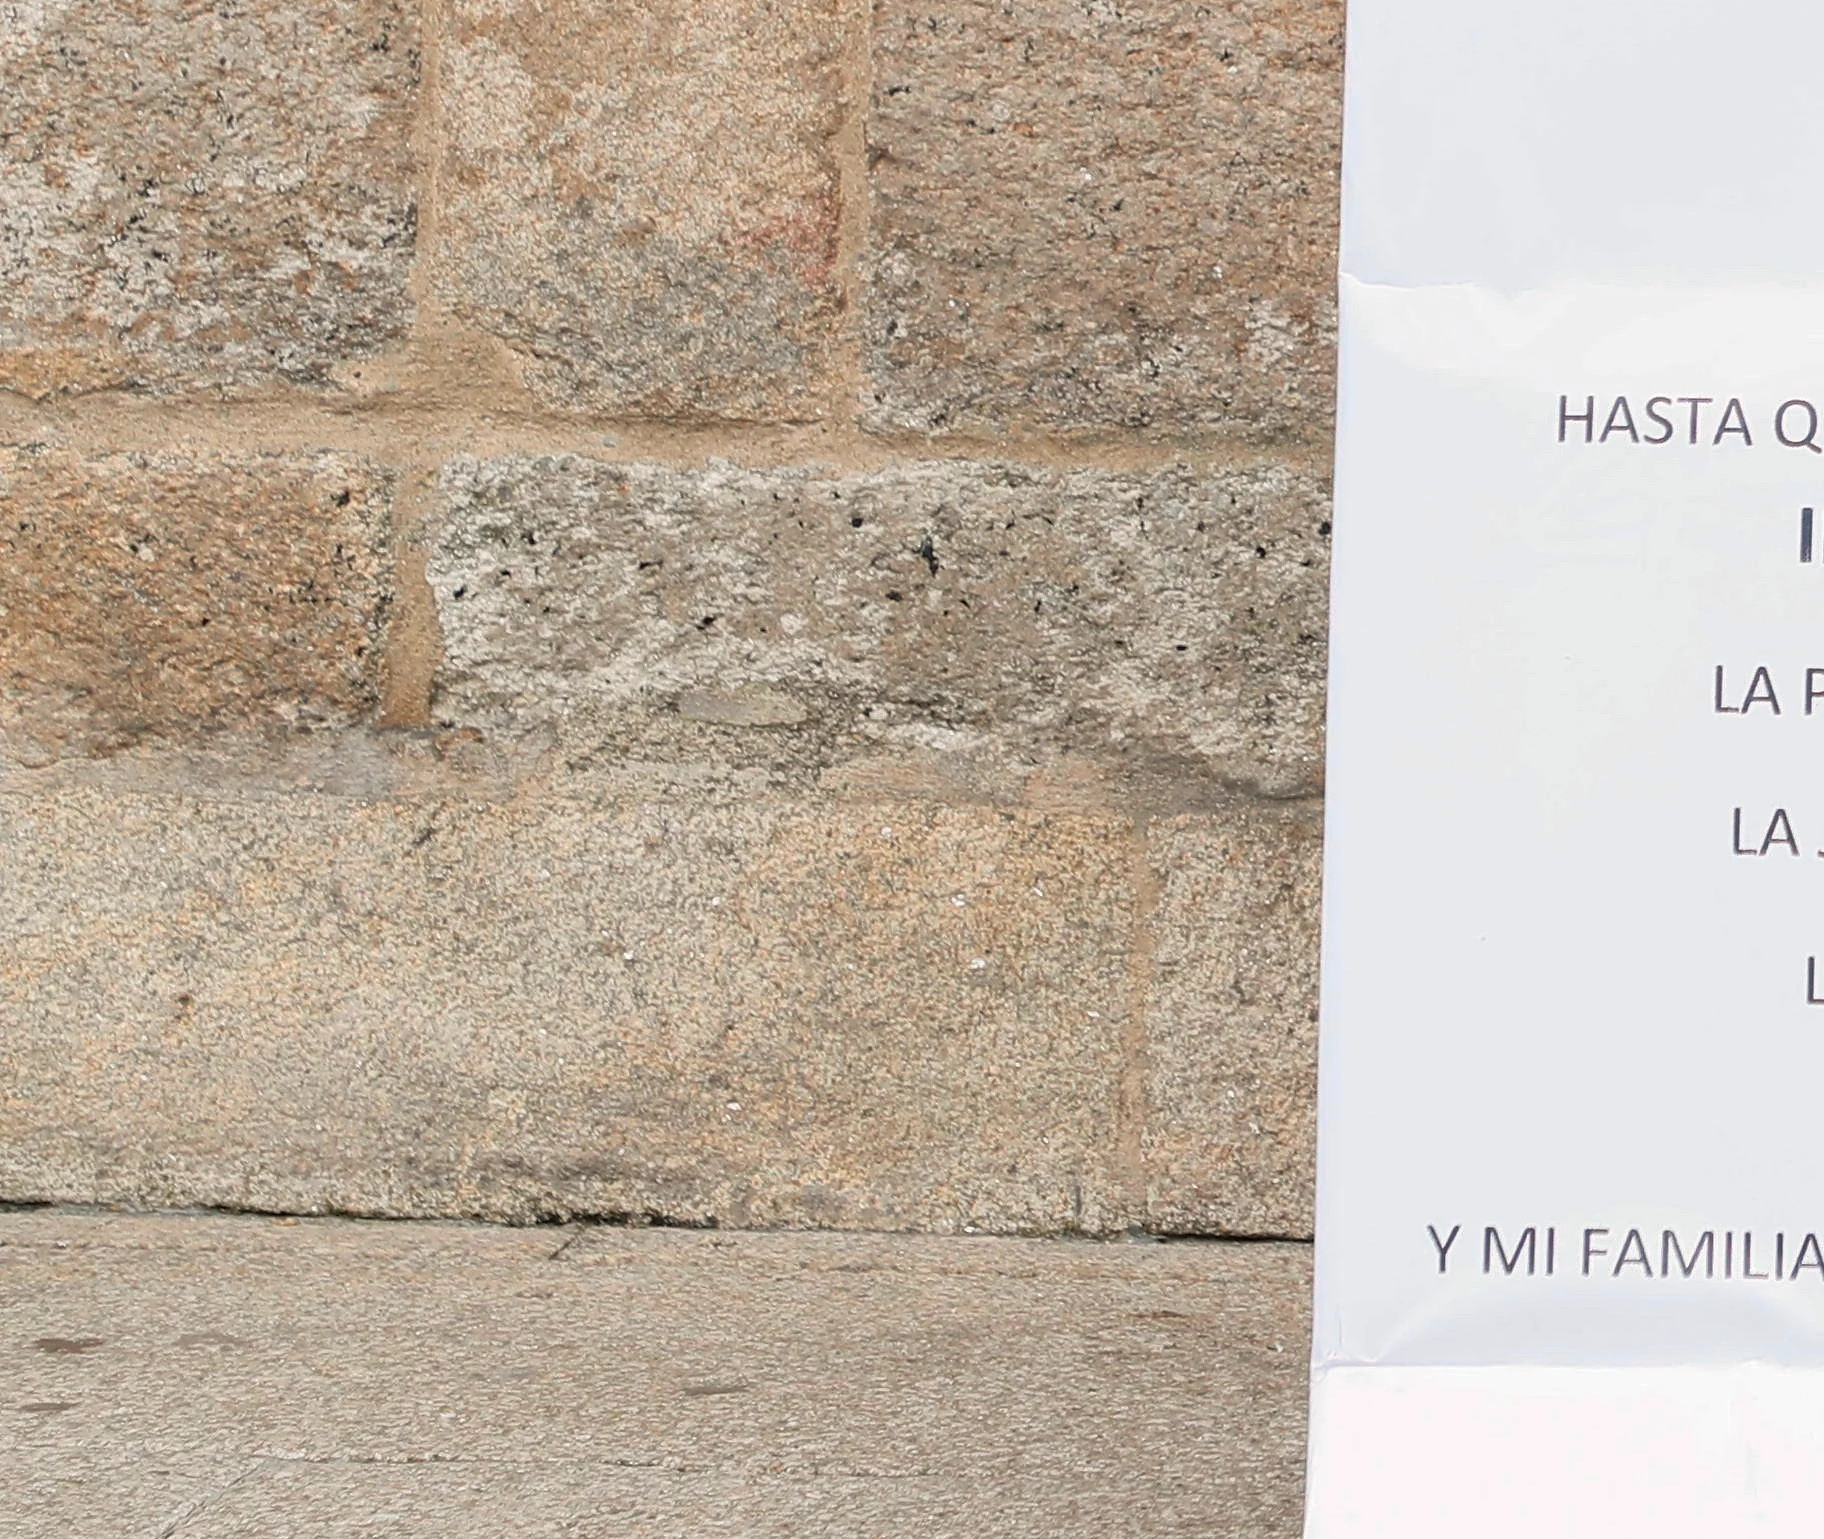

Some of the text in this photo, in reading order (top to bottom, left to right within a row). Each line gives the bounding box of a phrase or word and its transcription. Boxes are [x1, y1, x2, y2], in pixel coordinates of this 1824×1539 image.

[1557, 393, 1754, 448] HASTA
[1713, 663, 1783, 717] LA
[1731, 805, 1802, 858] LA
[1425, 1223, 1463, 1275] Y
[1481, 1225, 1557, 1277] MI
